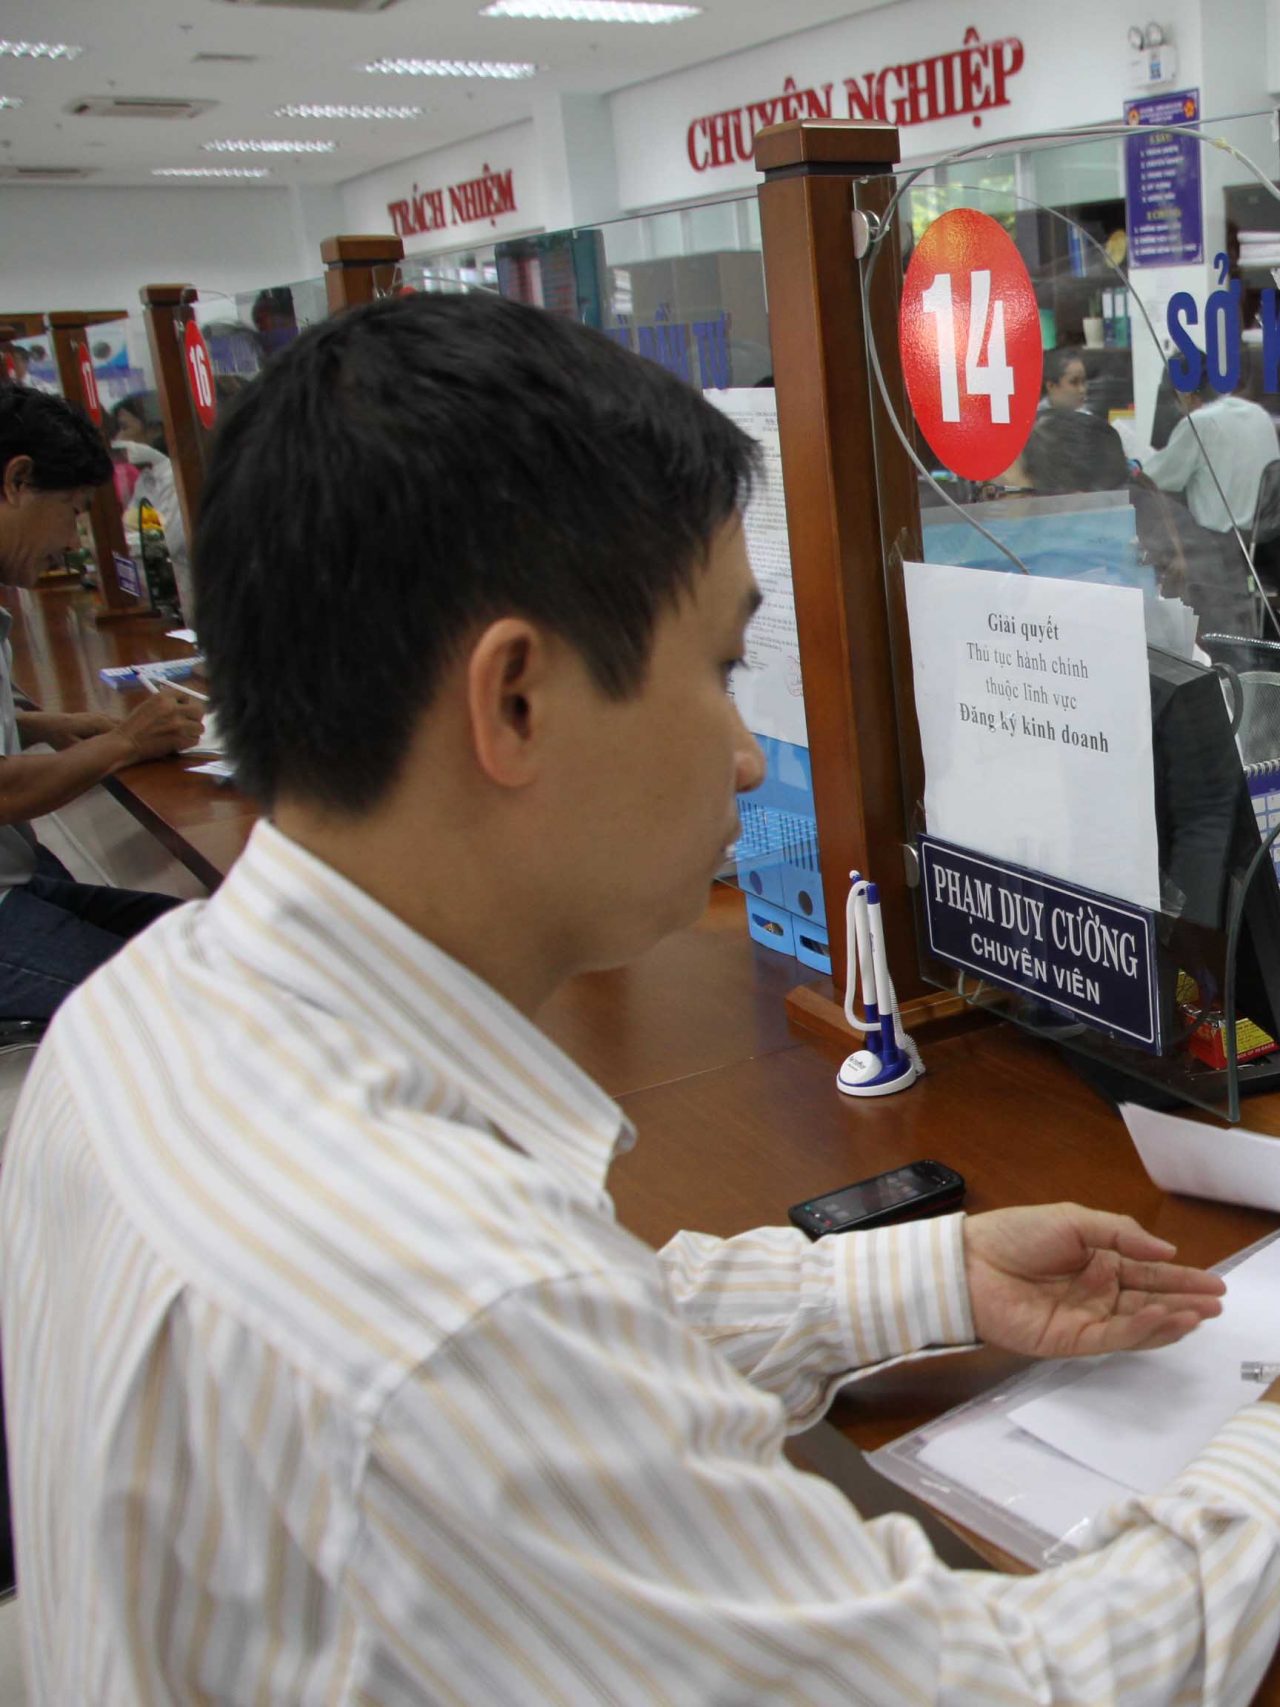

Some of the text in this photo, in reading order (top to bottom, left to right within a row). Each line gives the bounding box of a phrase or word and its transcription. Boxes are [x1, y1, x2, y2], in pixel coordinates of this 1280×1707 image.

[687, 26, 1024, 172] CHUYÊN NGHIỆP
[387, 162, 517, 237] TRÁCH NHIỆM
[922, 270, 1014, 424] 14
[1167, 252, 1241, 393] SỞ
[190, 344, 212, 407] 16
[966, 642, 1089, 679] Thủ tục hành chính
[988, 613, 1060, 643] Giải quyết
[959, 702, 1109, 753] Đăng ký kinh doanh
[986, 676, 1077, 712] thuộc lĩnh vực
[932, 864, 1138, 980] PHẠM DUY CƯỜNG
[971, 933, 1101, 1005] CHUYÊN VIÊN
